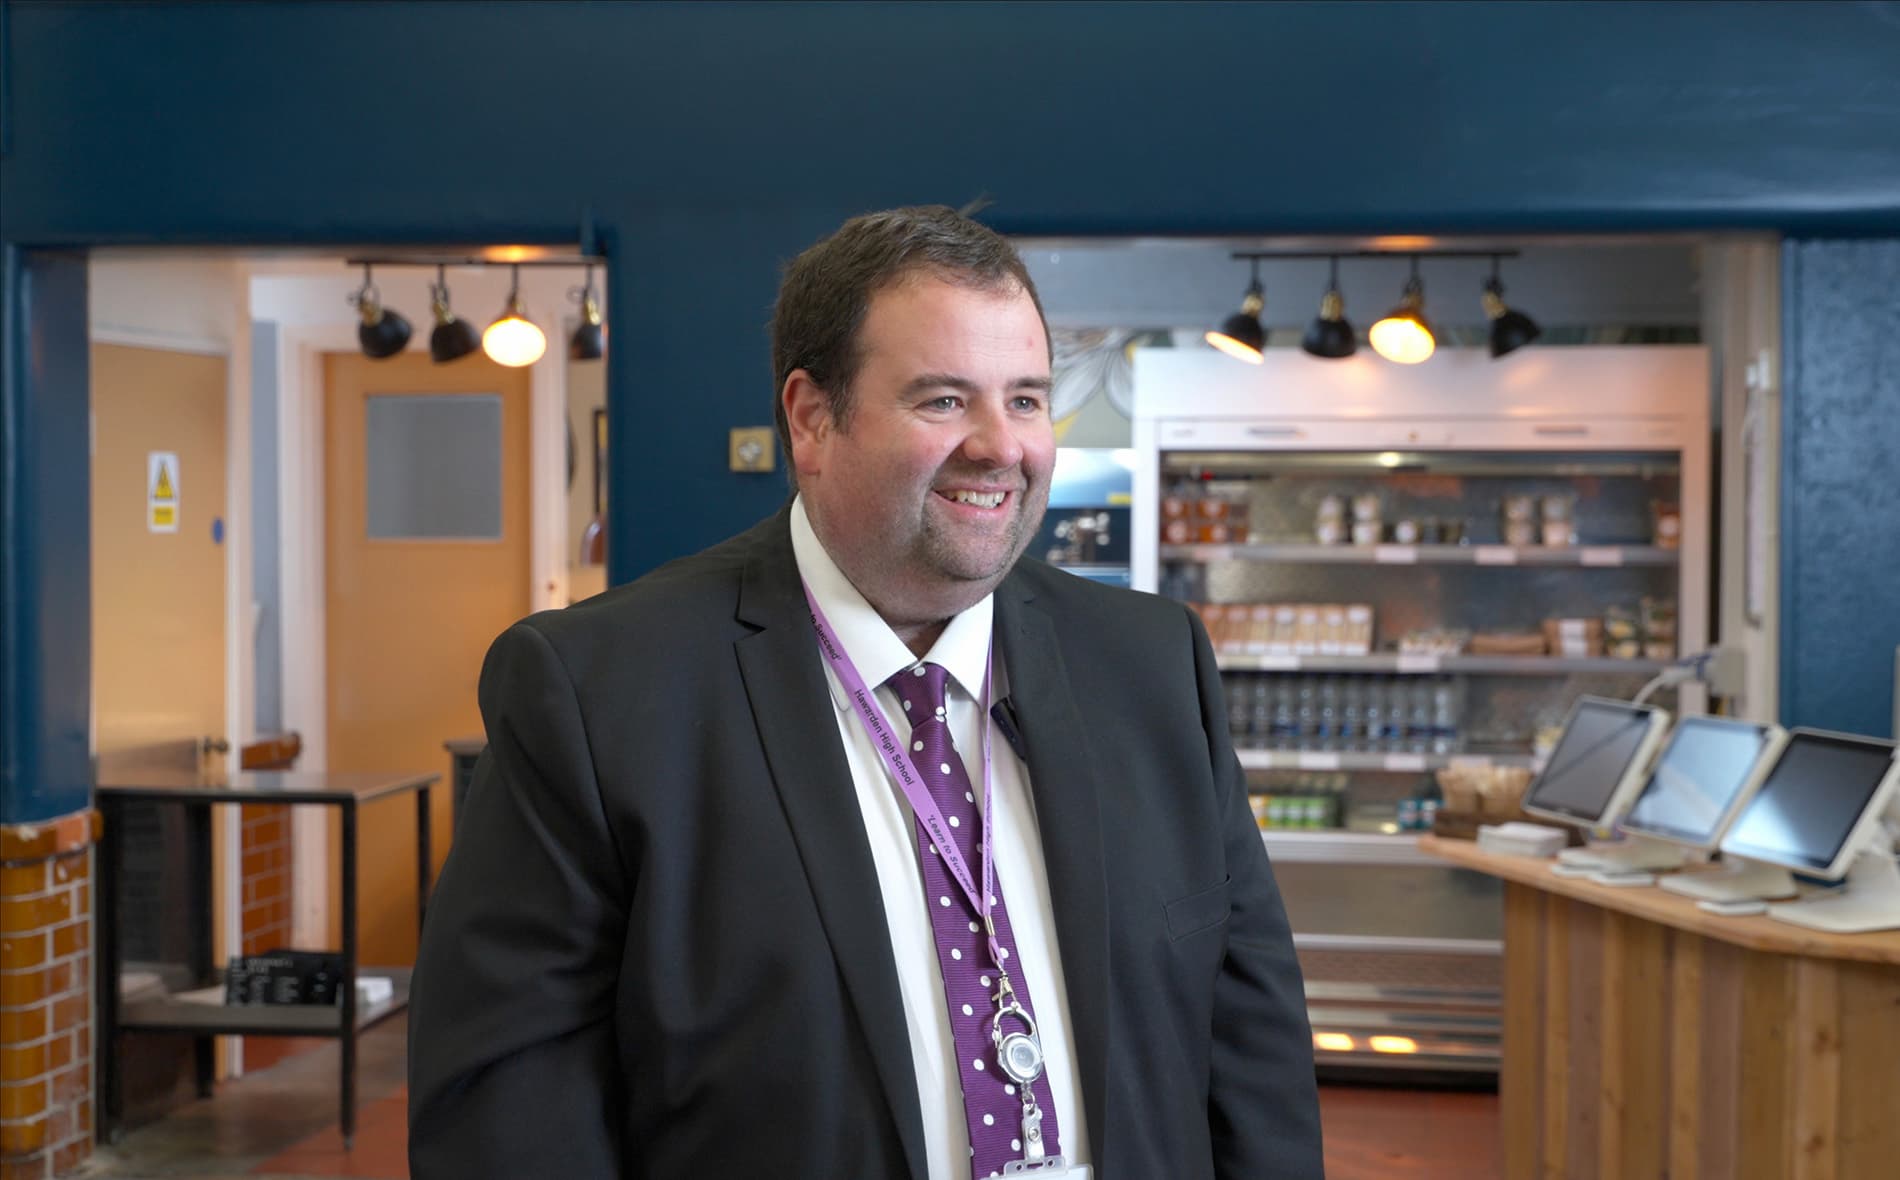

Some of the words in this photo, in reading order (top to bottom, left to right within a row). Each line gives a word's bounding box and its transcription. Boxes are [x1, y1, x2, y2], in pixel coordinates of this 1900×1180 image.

[854, 689, 883, 734] Hawarden
[880, 732, 895, 754] High
[892, 754, 915, 786] School
[943, 845, 952, 855] to
